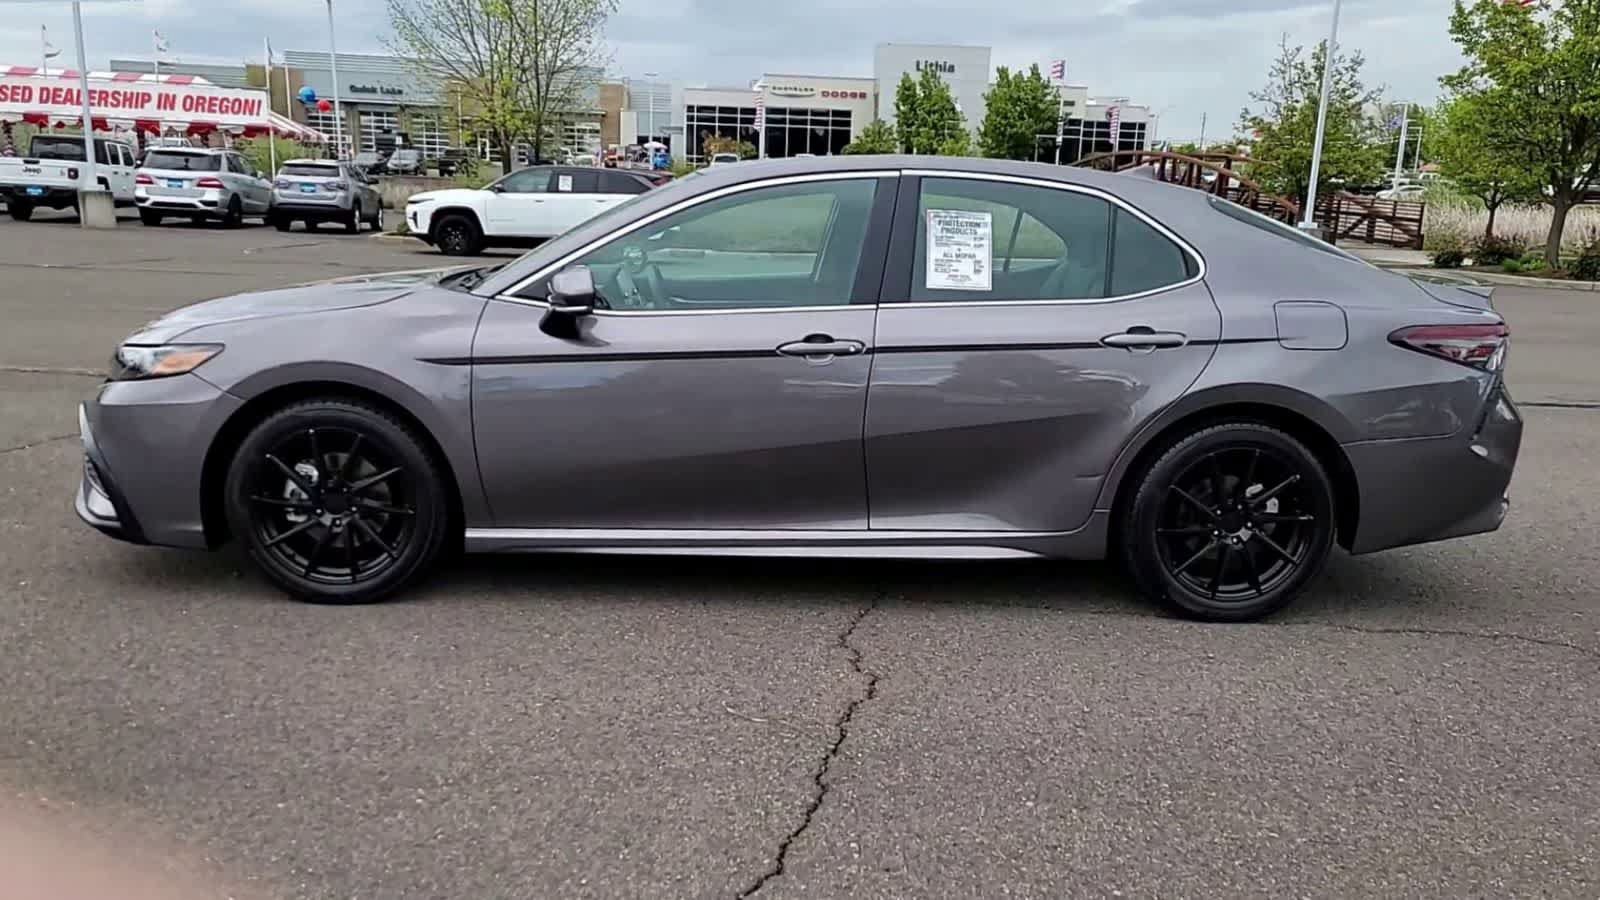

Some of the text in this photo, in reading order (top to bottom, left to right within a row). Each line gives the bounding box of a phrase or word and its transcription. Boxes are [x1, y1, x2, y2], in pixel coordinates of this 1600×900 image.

[916, 60, 955, 73] Lithia
[39, 87, 151, 109] DEALERSHIP
[156, 93, 177, 111] IN
[181, 95, 262, 116] OREGON!
